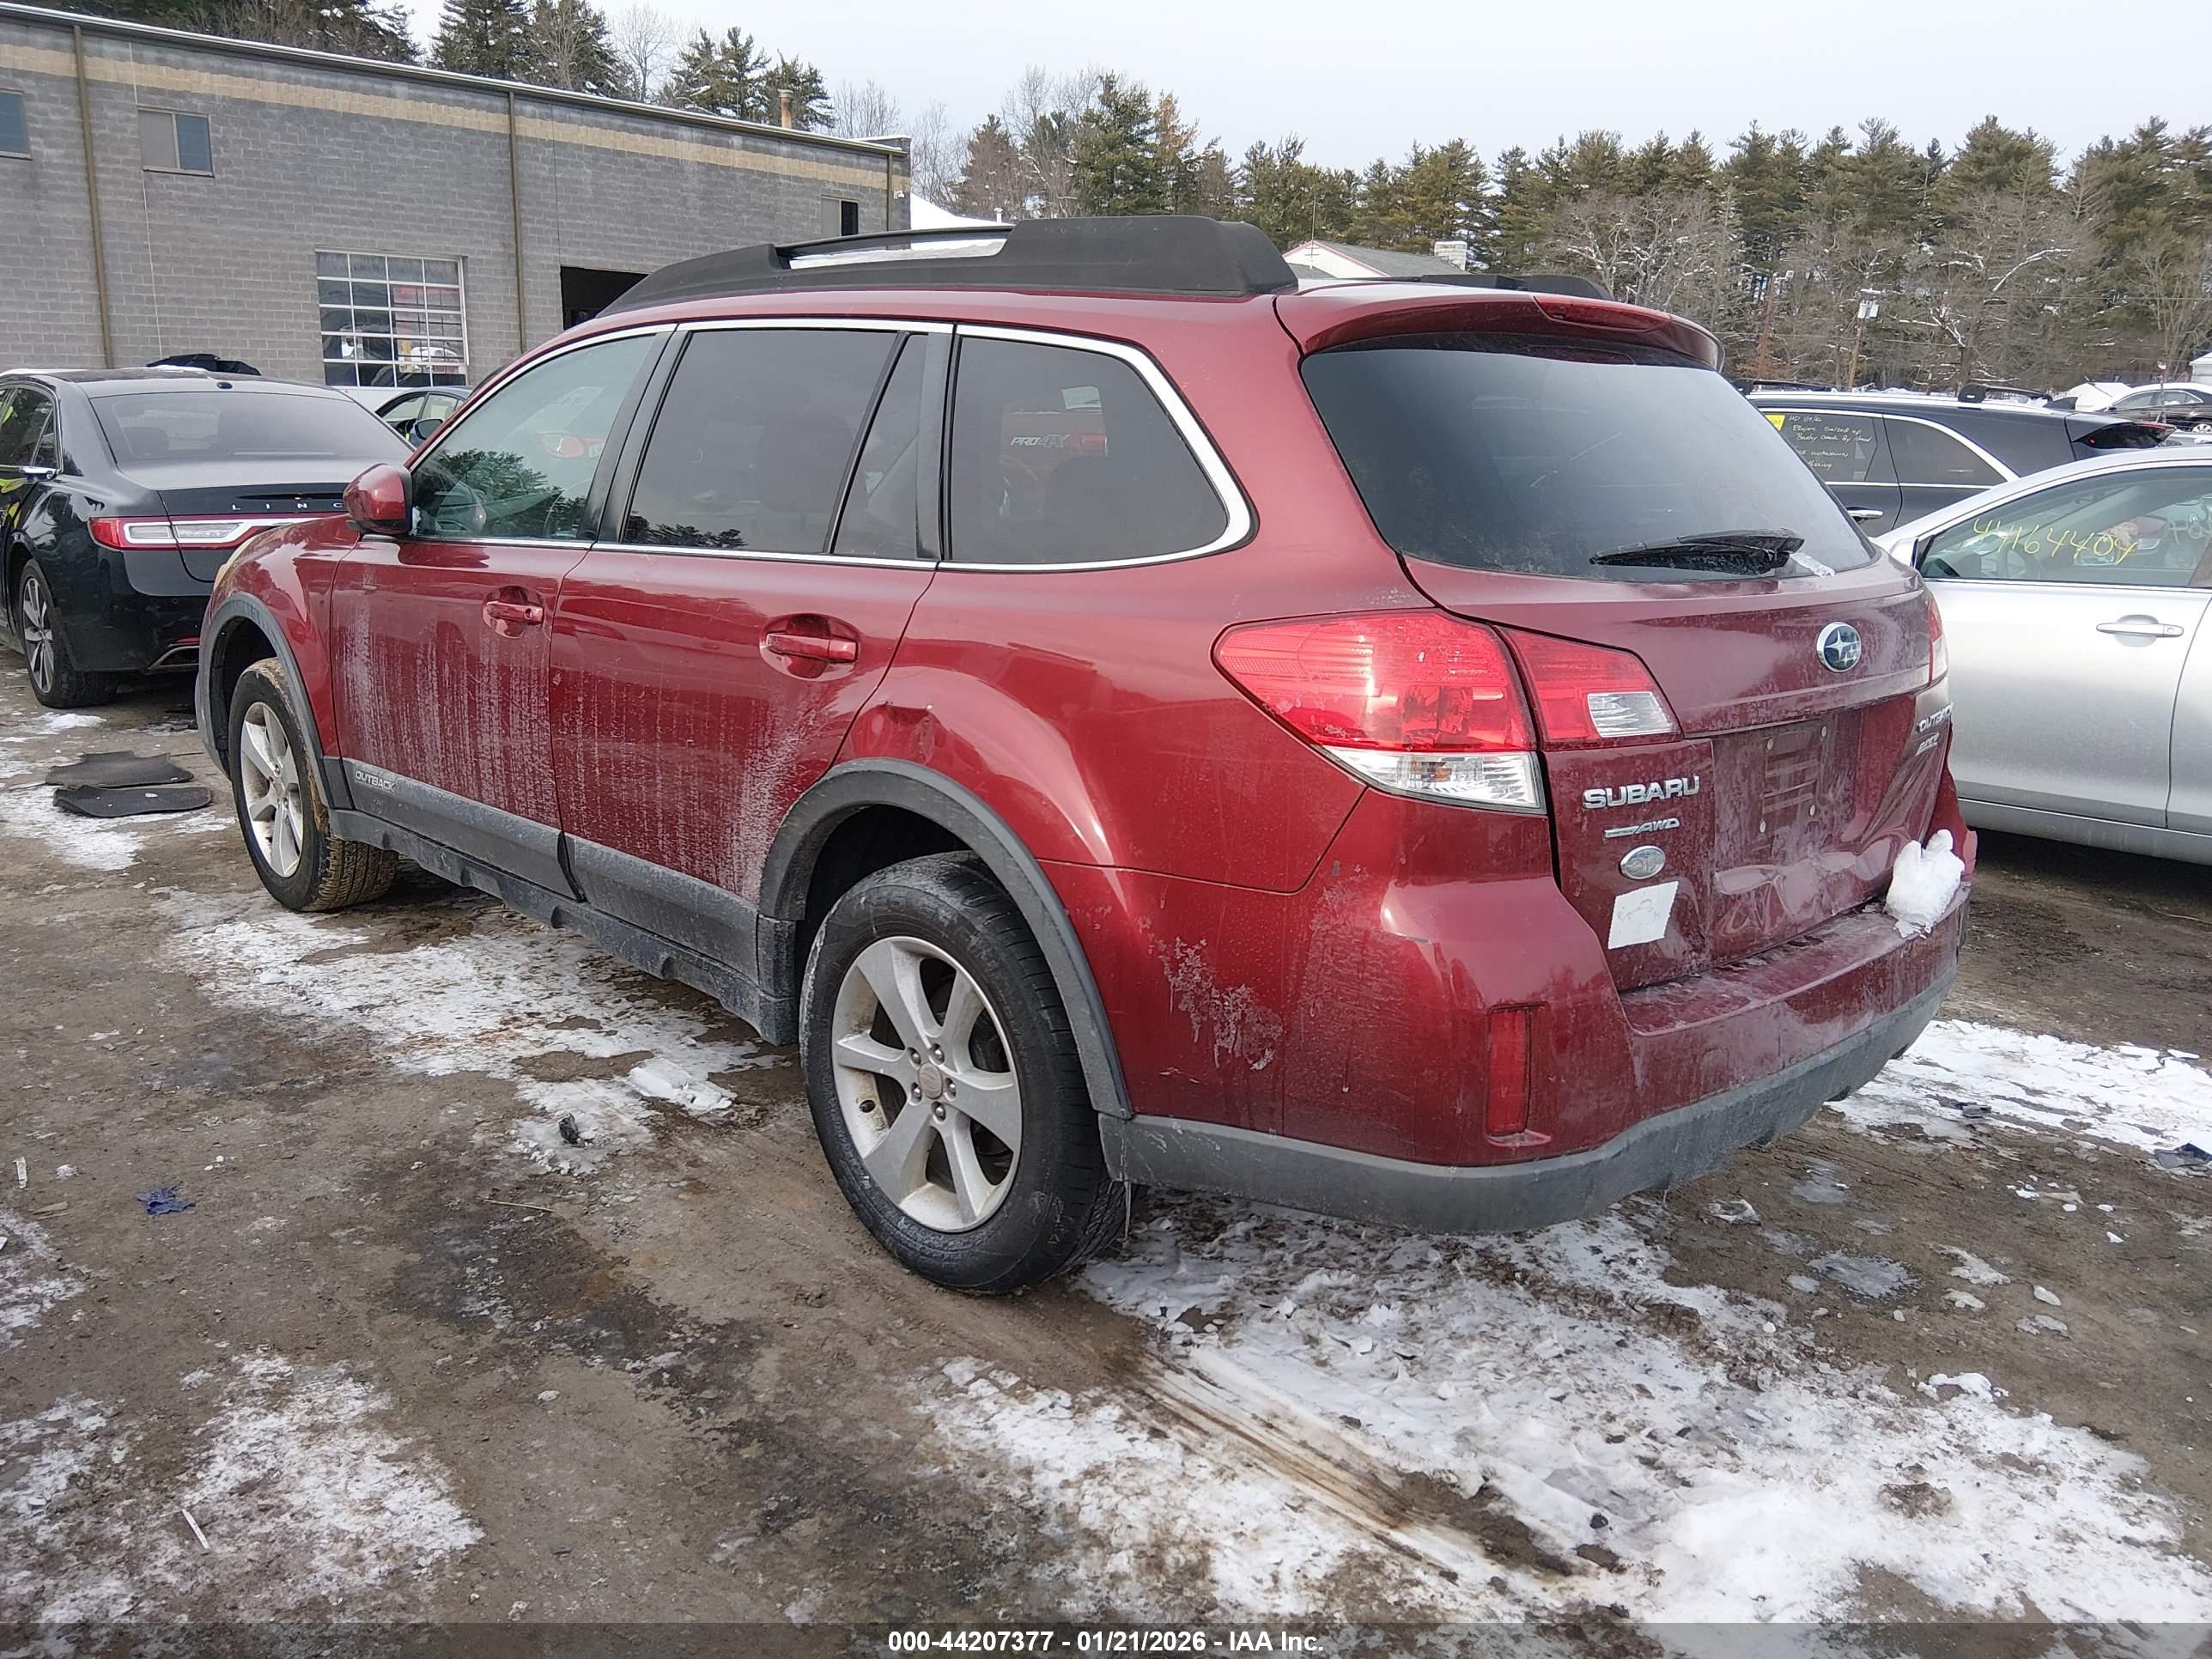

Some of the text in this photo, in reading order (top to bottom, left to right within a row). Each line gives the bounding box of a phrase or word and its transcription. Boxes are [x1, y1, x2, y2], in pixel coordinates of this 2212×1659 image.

[356, 770, 397, 793] OUTBACK
[1582, 775, 1700, 810] SUBARU
[1635, 817, 1680, 835] AWD
